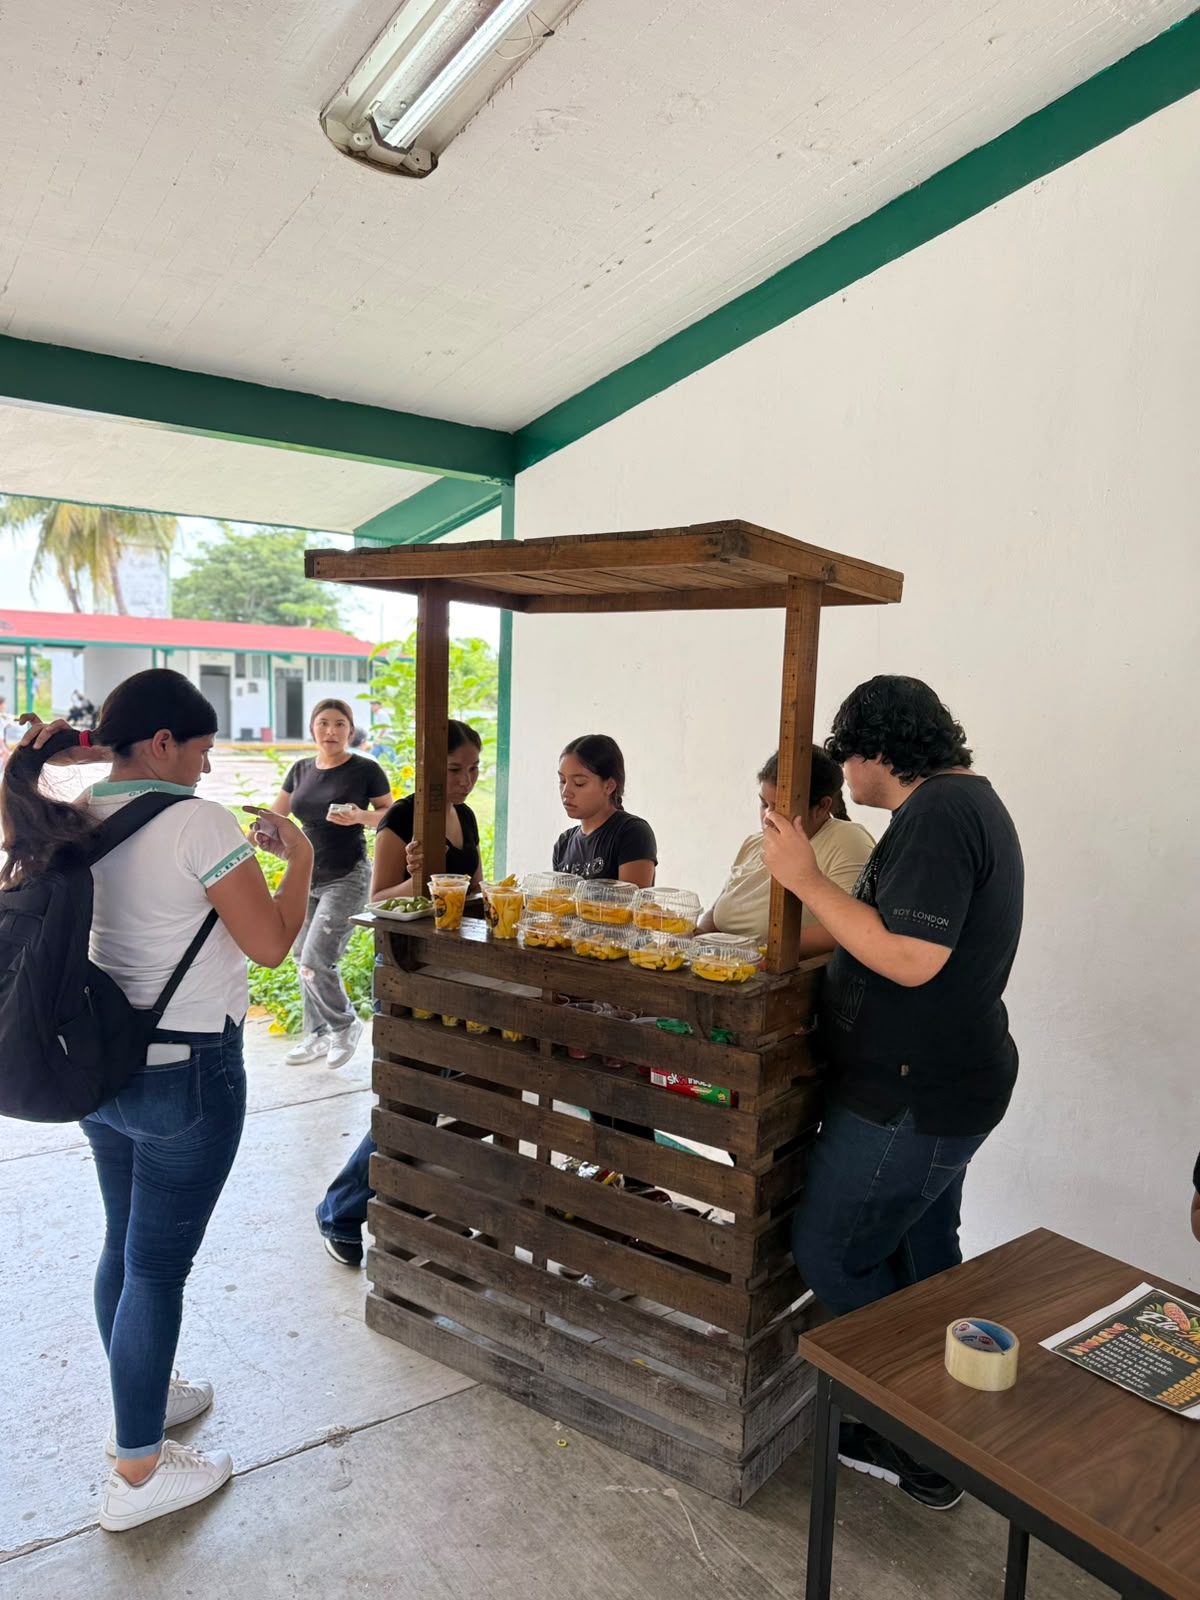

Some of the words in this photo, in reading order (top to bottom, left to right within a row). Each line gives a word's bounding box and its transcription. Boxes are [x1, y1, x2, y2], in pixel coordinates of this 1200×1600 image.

[912, 910, 950, 926] LONDON
[1105, 1343, 1126, 1354] ELOTE
[1111, 1340, 1132, 1350] ELOTE
[1117, 1336, 1142, 1349] MANGO
[1141, 1348, 1174, 1365] FORRADO:
[1087, 1353, 1108, 1364] ELOTE
[1094, 1350, 1118, 1362] MANGO
[1100, 1347, 1124, 1359] MANGO
[1082, 1356, 1103, 1367] ELOTE
